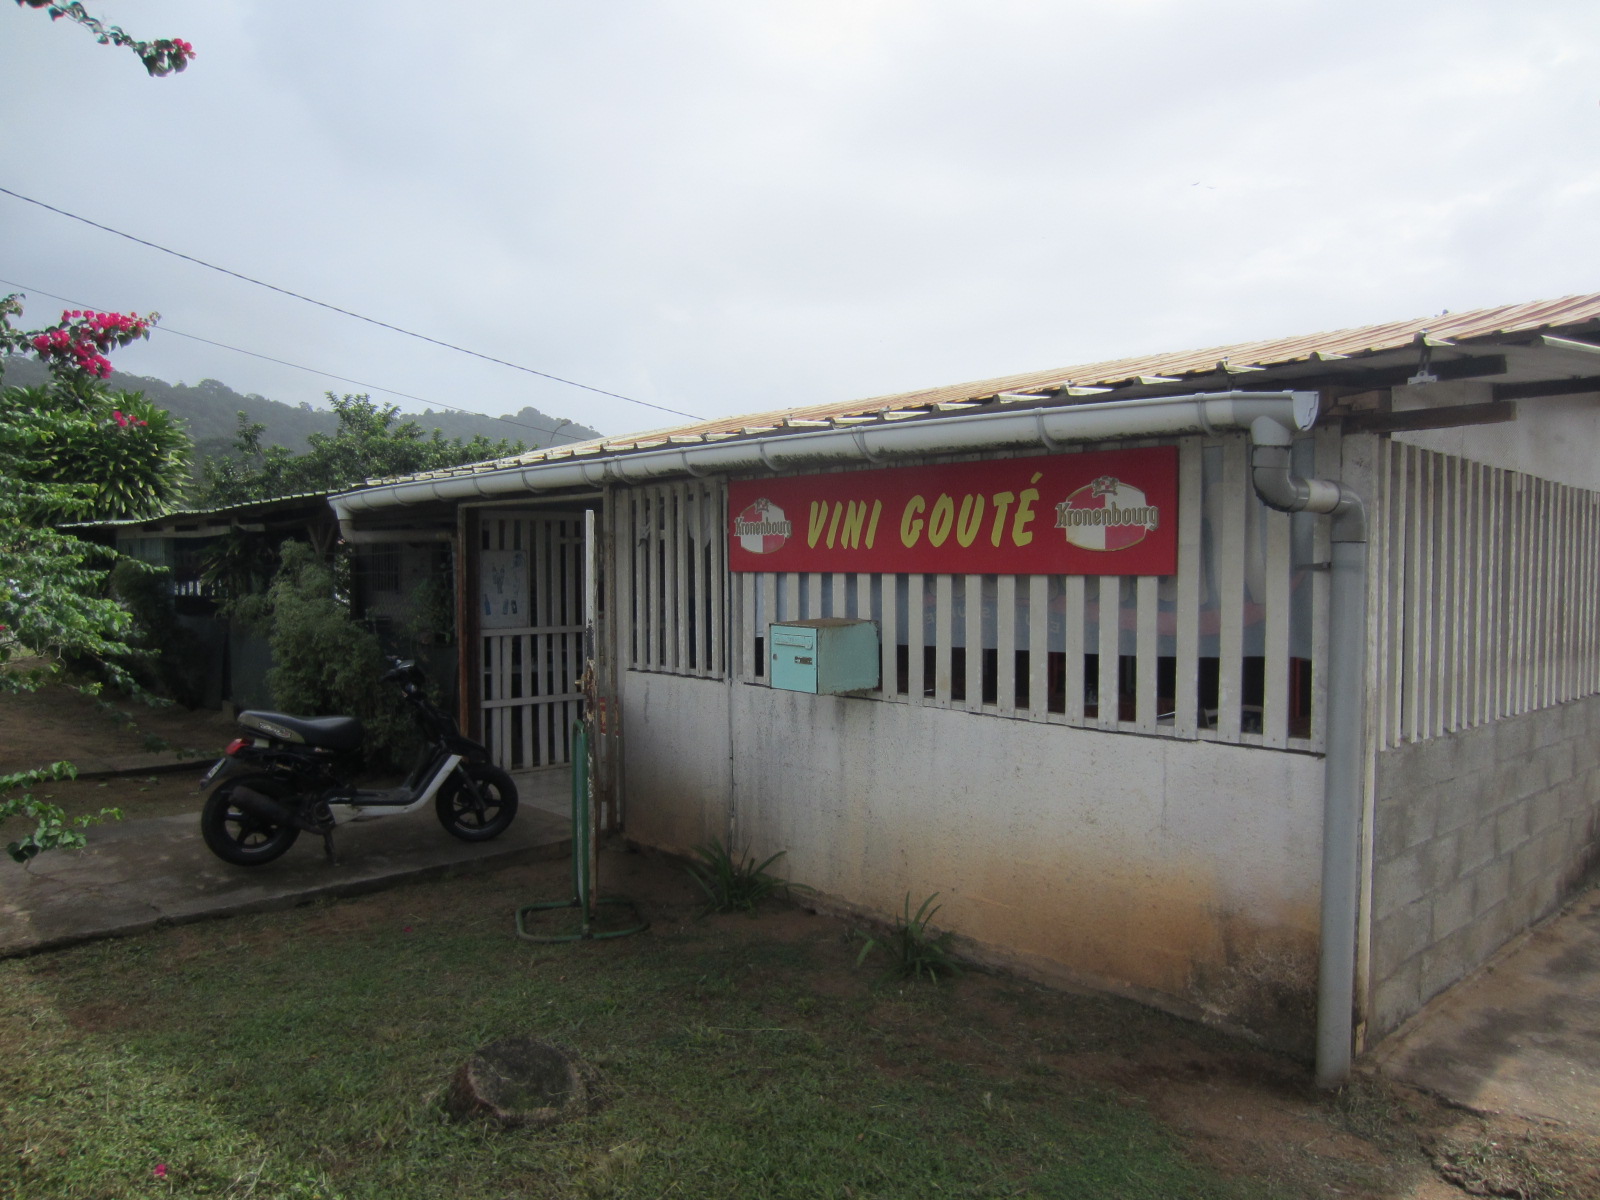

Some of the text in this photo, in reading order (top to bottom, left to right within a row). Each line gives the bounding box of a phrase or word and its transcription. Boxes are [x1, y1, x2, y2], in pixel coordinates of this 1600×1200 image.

[807, 471, 1043, 550] VINI GOUTÉ
[1054, 501, 1160, 531] Kronenbourg
[734, 516, 791, 538] Kronenbourg
